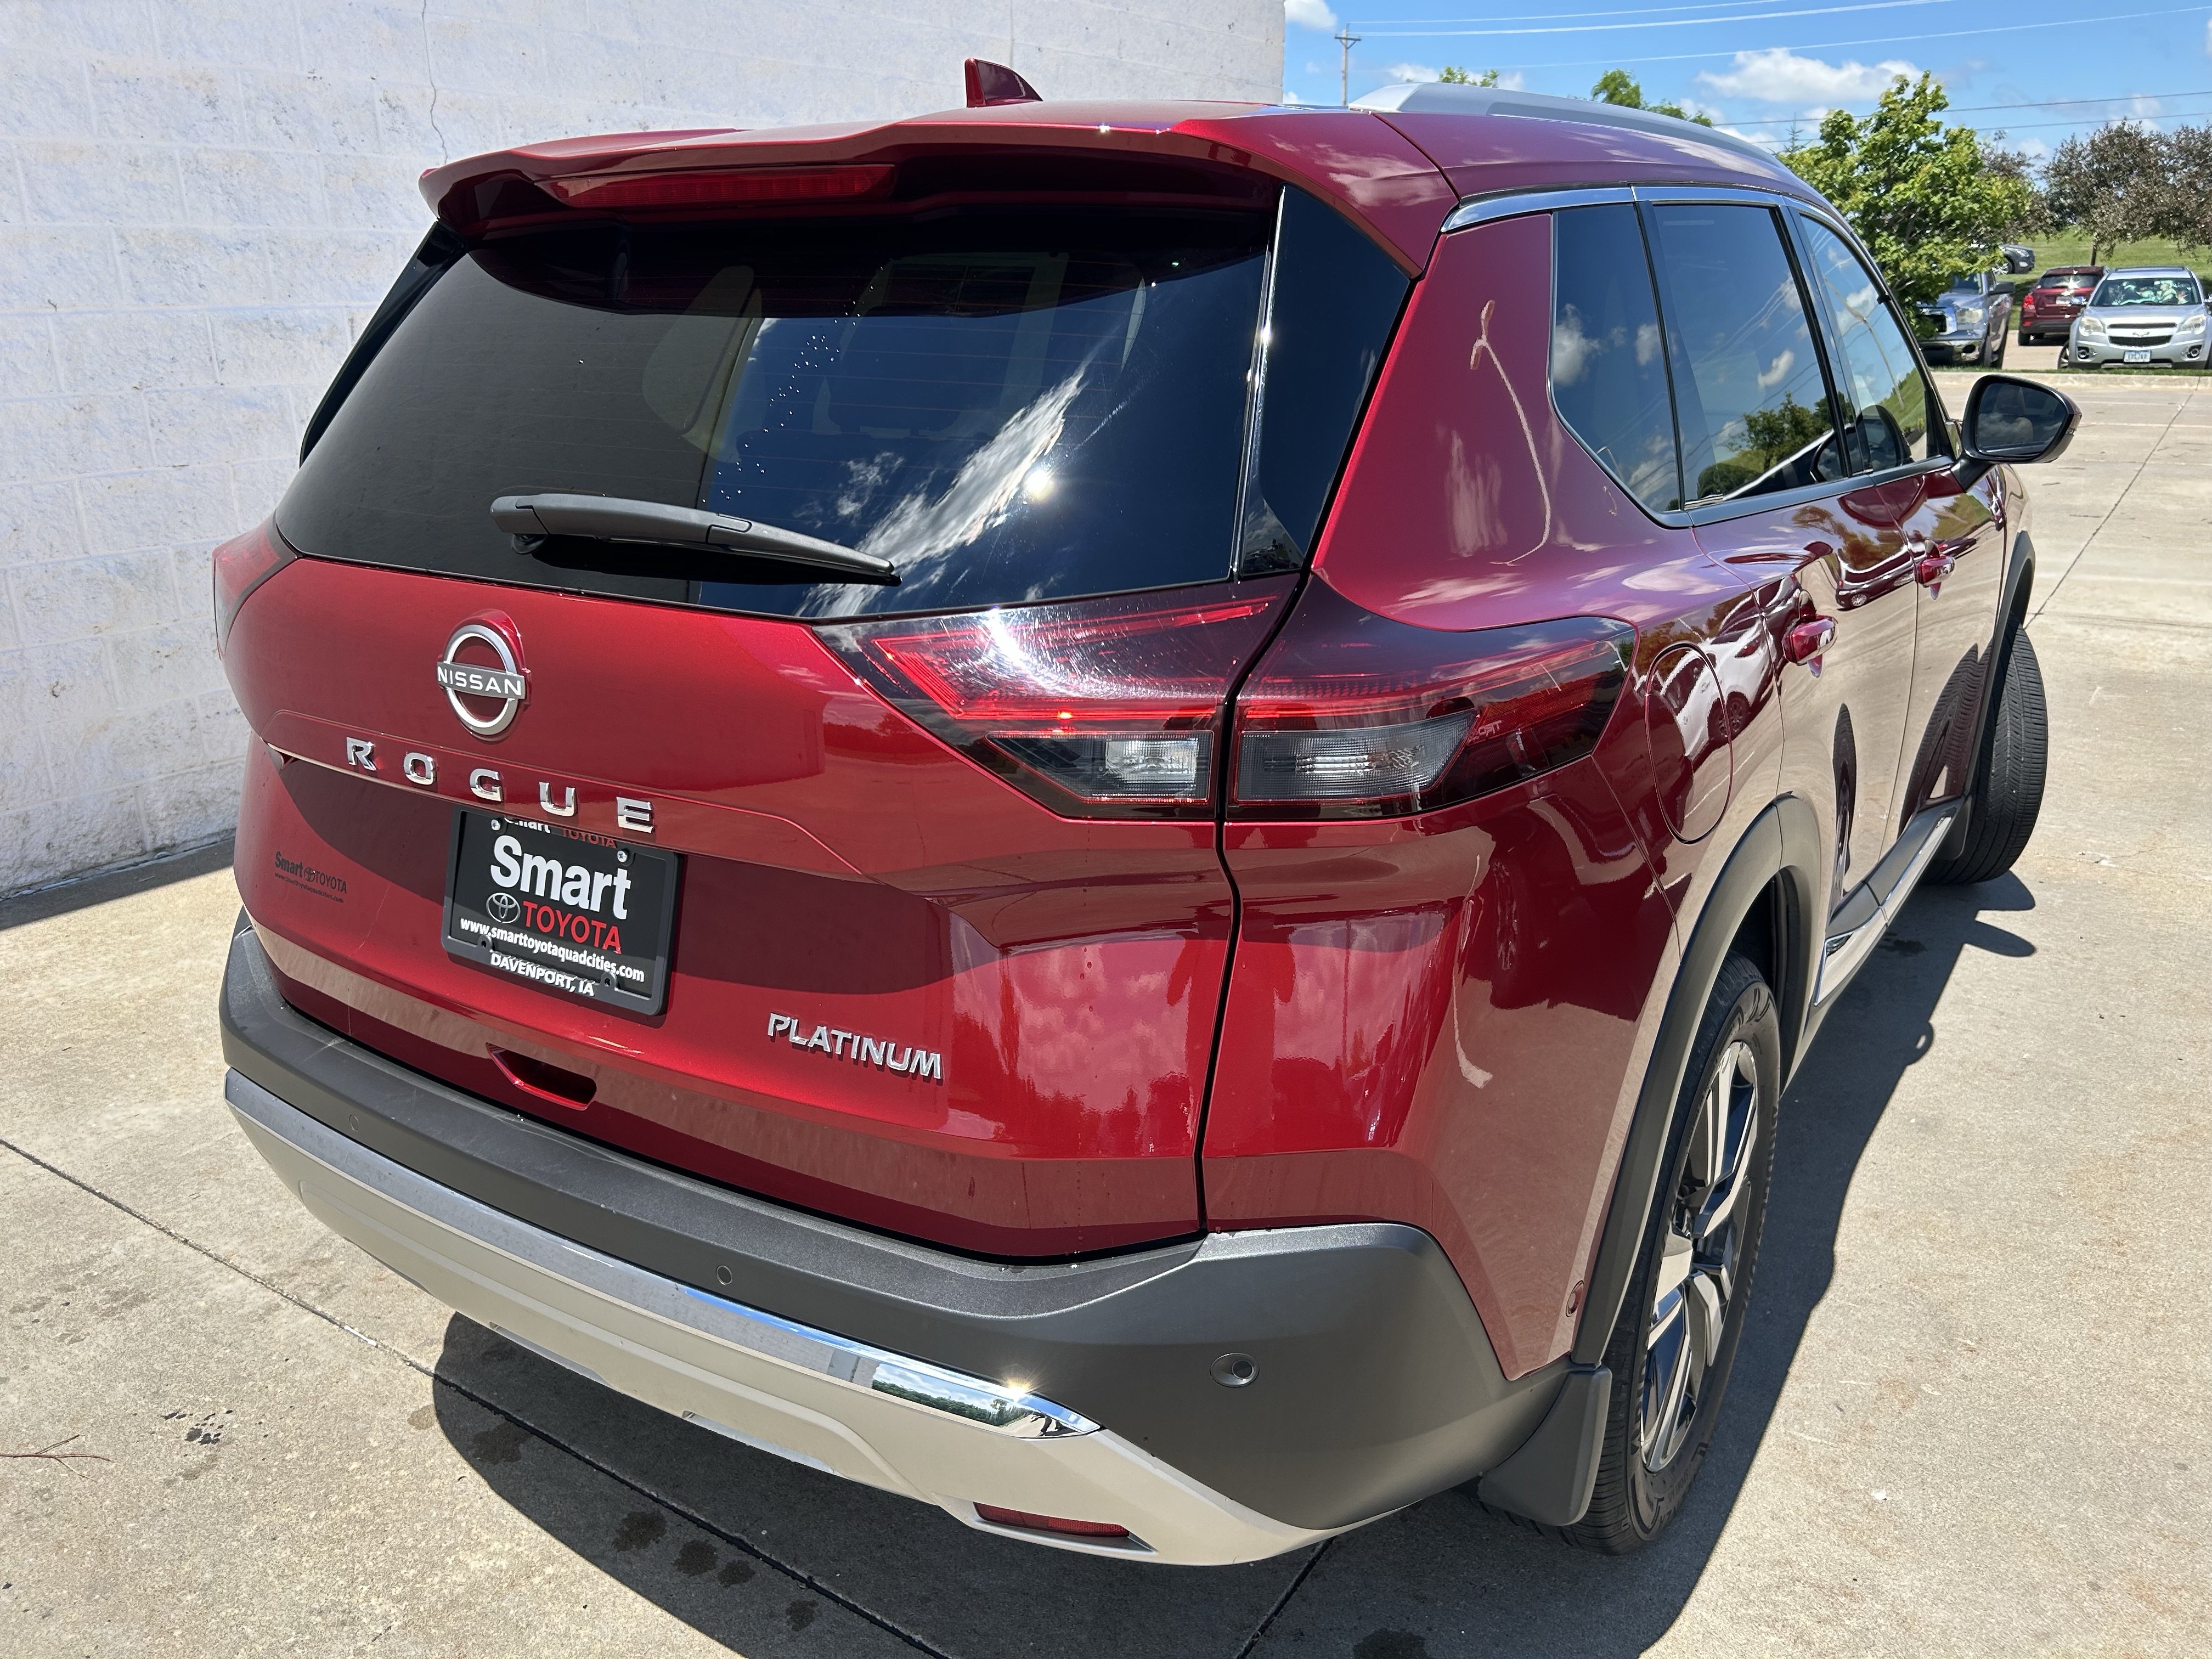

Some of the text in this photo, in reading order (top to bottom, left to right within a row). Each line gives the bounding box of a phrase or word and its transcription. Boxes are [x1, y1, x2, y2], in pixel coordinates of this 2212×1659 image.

[437, 666, 521, 696] NISSAN
[346, 737, 655, 833] ROGUE
[275, 851, 347, 894] Smart TOYOTA
[490, 835, 631, 920] Smart
[460, 918, 645, 983] www.smarttoyotaquadcities.com
[523, 901, 623, 955] TOYOTA
[490, 952, 595, 997] DAVENPORT, IA
[768, 1012, 944, 1080] PLATINUM
